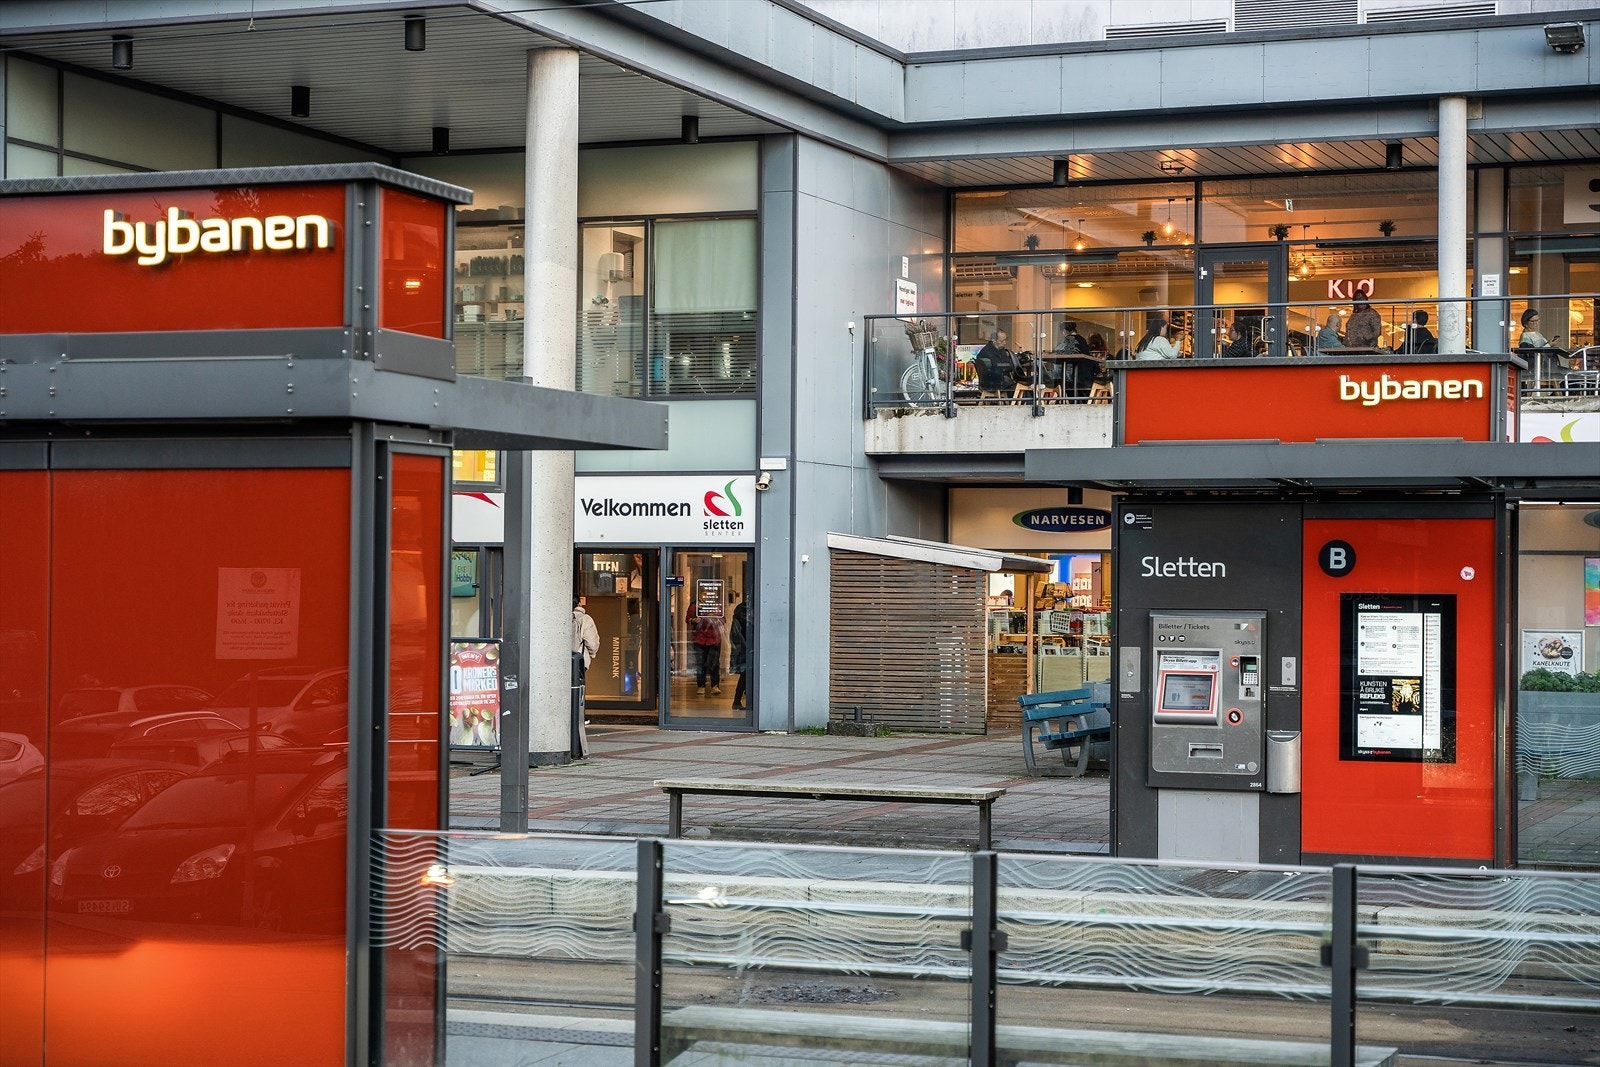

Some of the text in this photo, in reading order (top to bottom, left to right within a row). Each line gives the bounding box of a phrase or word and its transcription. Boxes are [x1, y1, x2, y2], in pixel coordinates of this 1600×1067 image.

[103, 206, 330, 267] bybanen
[1339, 374, 1484, 407] bybanen
[581, 498, 692, 517] Velkommen
[703, 519, 744, 530] sletten
[1031, 515, 1105, 525] NARVESEN
[1141, 556, 1226, 578] Sletten
[1329, 547, 1347, 569] B
[461, 652, 480, 660] MENY
